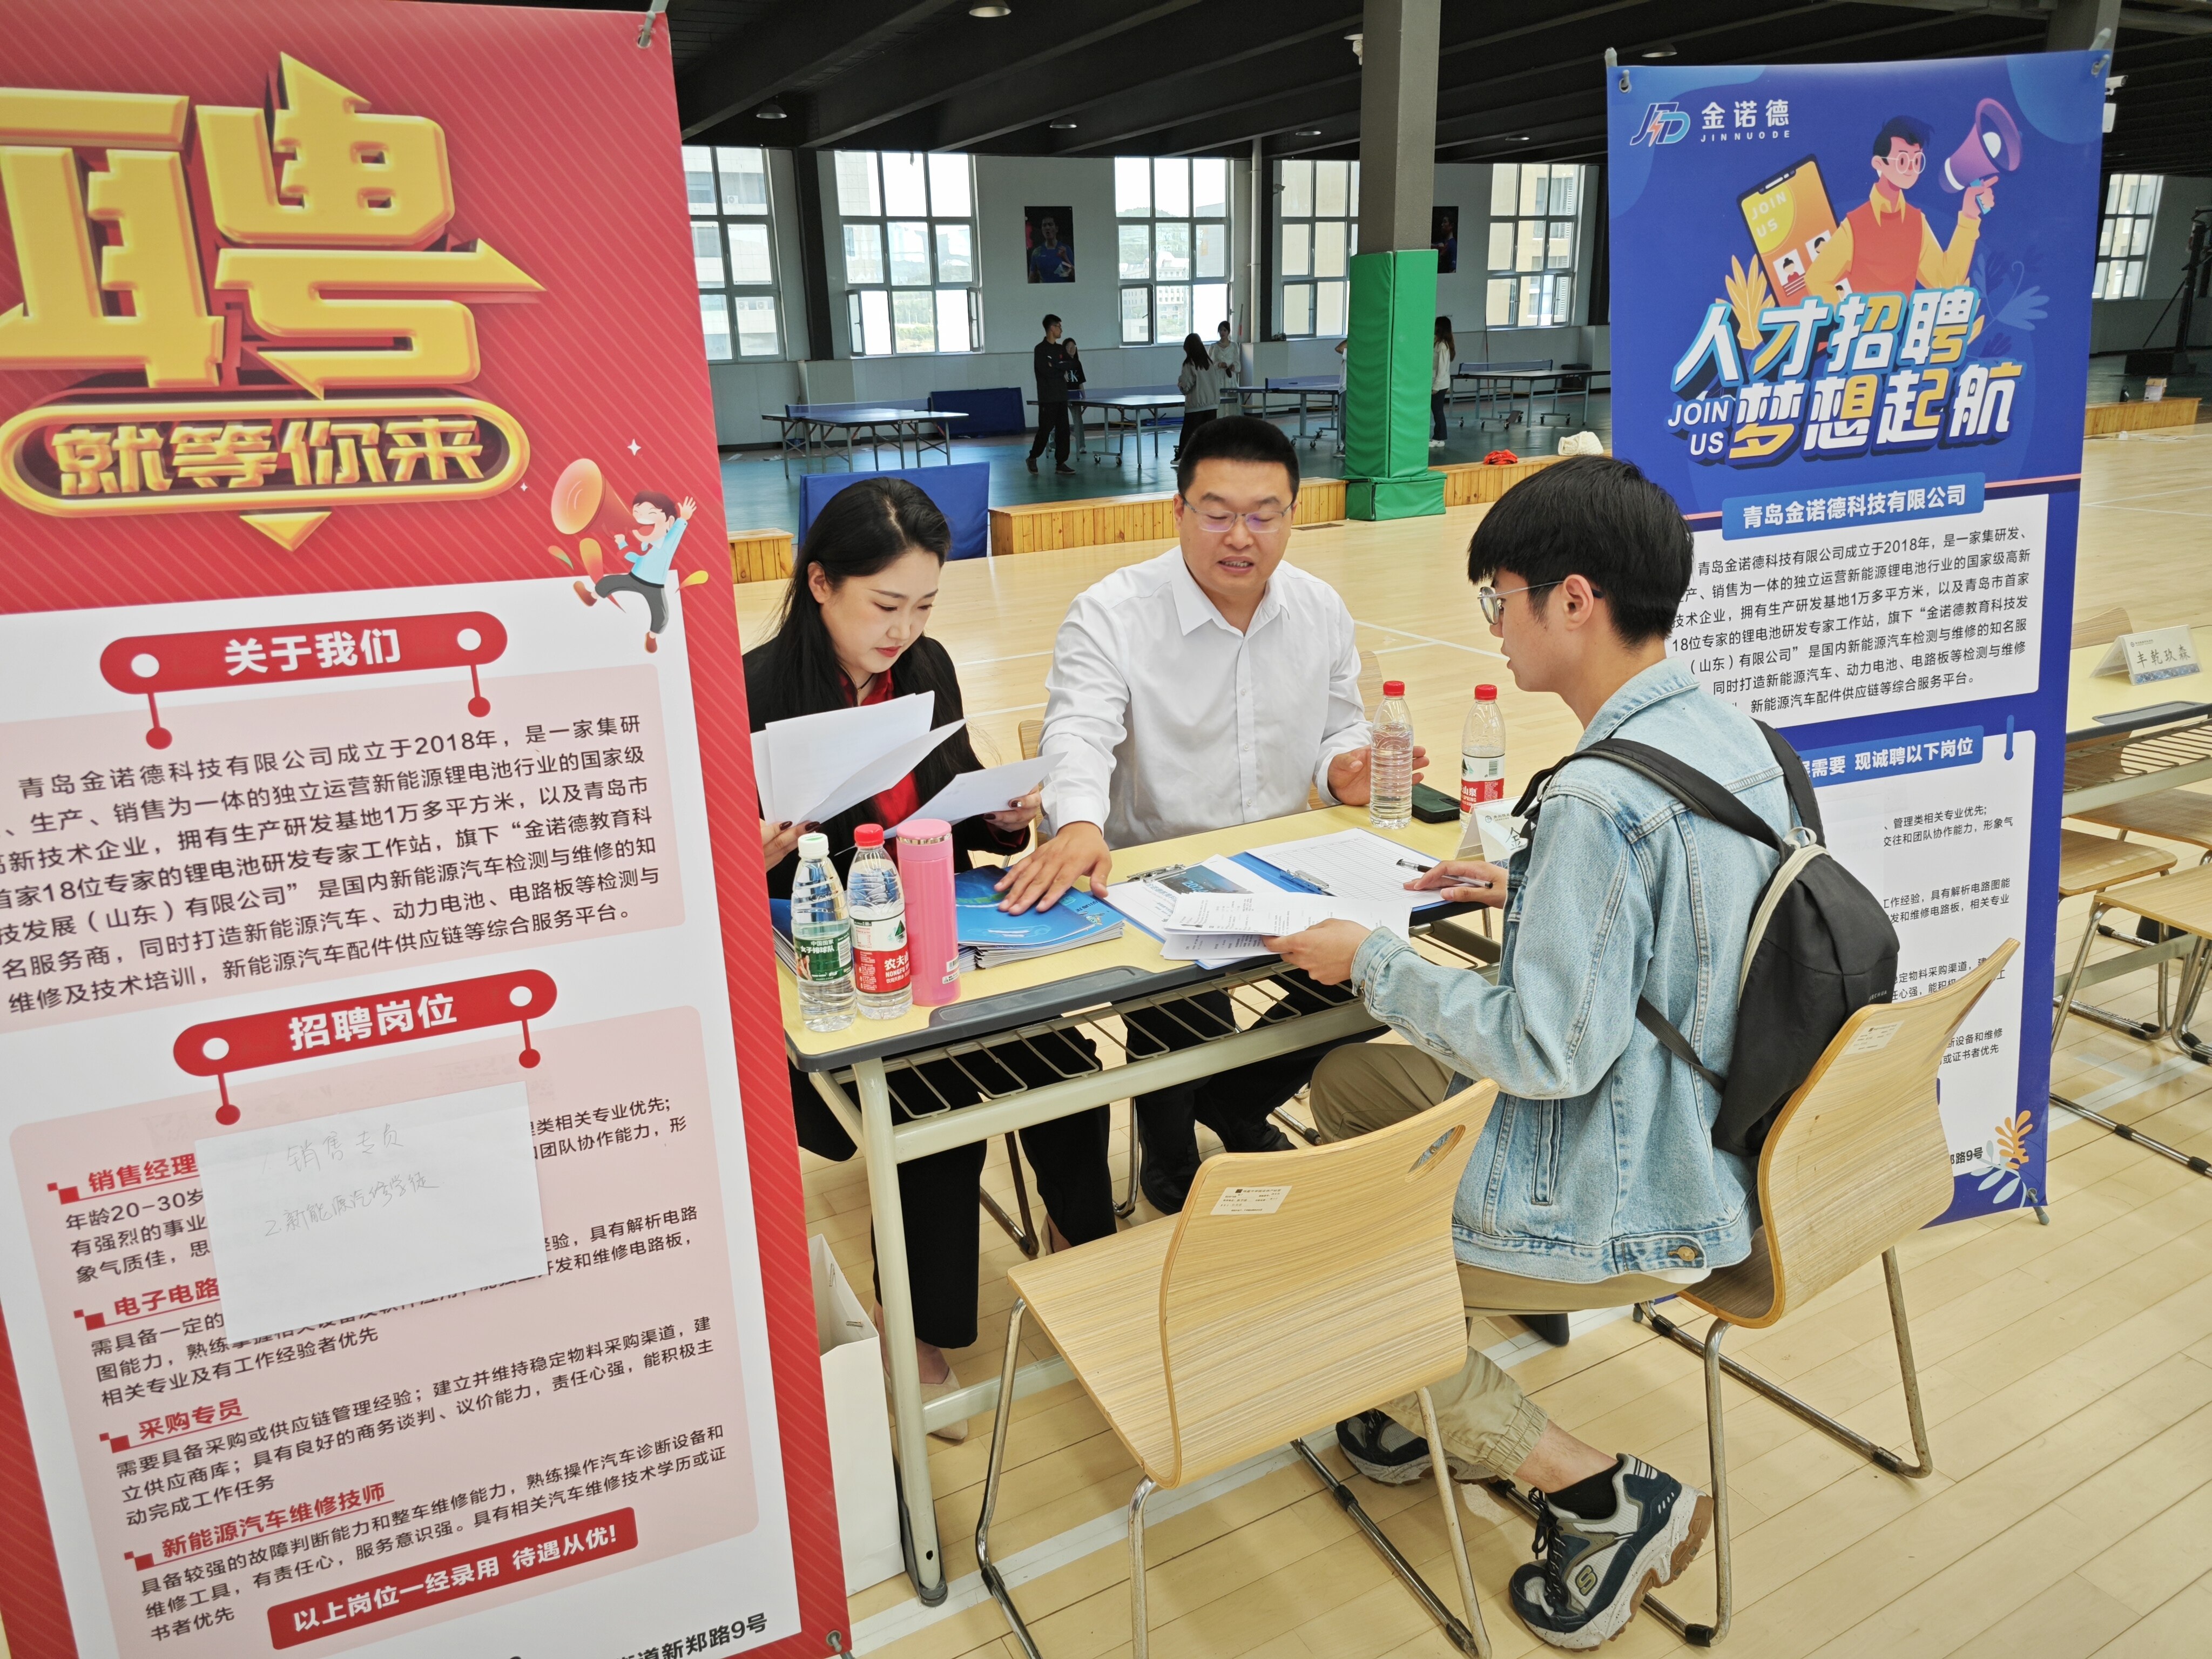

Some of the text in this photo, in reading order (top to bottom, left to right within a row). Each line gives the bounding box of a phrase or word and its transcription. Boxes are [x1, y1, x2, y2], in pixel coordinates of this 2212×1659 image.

[1701, 130, 1790, 142] JINNUODE
[1702, 99, 1789, 129] 金诺德
[1751, 191, 1787, 220] JOIN
[1756, 218, 1778, 238] US
[1673, 288, 1977, 387] 人才招聘
[1668, 400, 1729, 428] JOIN
[1729, 361, 2023, 459] 梦想起航
[51, 418, 483, 495] 就等你来
[1690, 431, 1724, 455] US
[1743, 484, 1966, 529] 青岛金诺德科技有限公司
[1698, 527, 2026, 576] 青岛金诺德科技有限公司成立于2018年，是一家集研发、
[1679, 549, 2031, 603] 产、销售为一体的独立运营新能源锂电池行业的国家级高新
[225, 628, 402, 676] 关于我们
[1714, 641, 2026, 695] 同时打造新能源汽车、动力电池、电路板等检测与维修
[18, 714, 640, 799] 青岛金诺德科技有限公司成立于2018年，是一家集研
[1855, 737, 1973, 771] 现诚聘以下岗位
[1461, 785, 1477, 797] 山泉
[0, 776, 648, 874] 新技术企业，拥有生产研发基地1万多平方米，以及青岛市
[1888, 893, 2009, 924] 发和维修电路板，相关专业
[800, 945, 834, 954] 女子排球队
[886, 966, 905, 978] NONGFU
[288, 993, 457, 1051] 招聘岗位
[1940, 1043, 1999, 1064] 或证书者优先
[287, 1123, 404, 1172] 销售专员
[71, 1116, 686, 1257] 有强烈的事业 团队协作能力，形
[88, 1153, 198, 1192] 销售经理
[76, 1239, 211, 1284] 象气质佳，思
[114, 1278, 220, 1317] 电子电路
[91, 1312, 225, 1358] 需具备一定的
[102, 1326, 379, 1407] 相关专业及有工作经验者优先
[138, 1398, 243, 1440] 采购专员
[126, 1474, 275, 1526] 动完成工作任务
[161, 1482, 386, 1559] 新能源汽车维修技师
[293, 1557, 500, 1632] 以上岗位一经录用
[151, 1607, 235, 1642] 书者优先
[617, 1612, 767, 1659] 道新郑路9号
